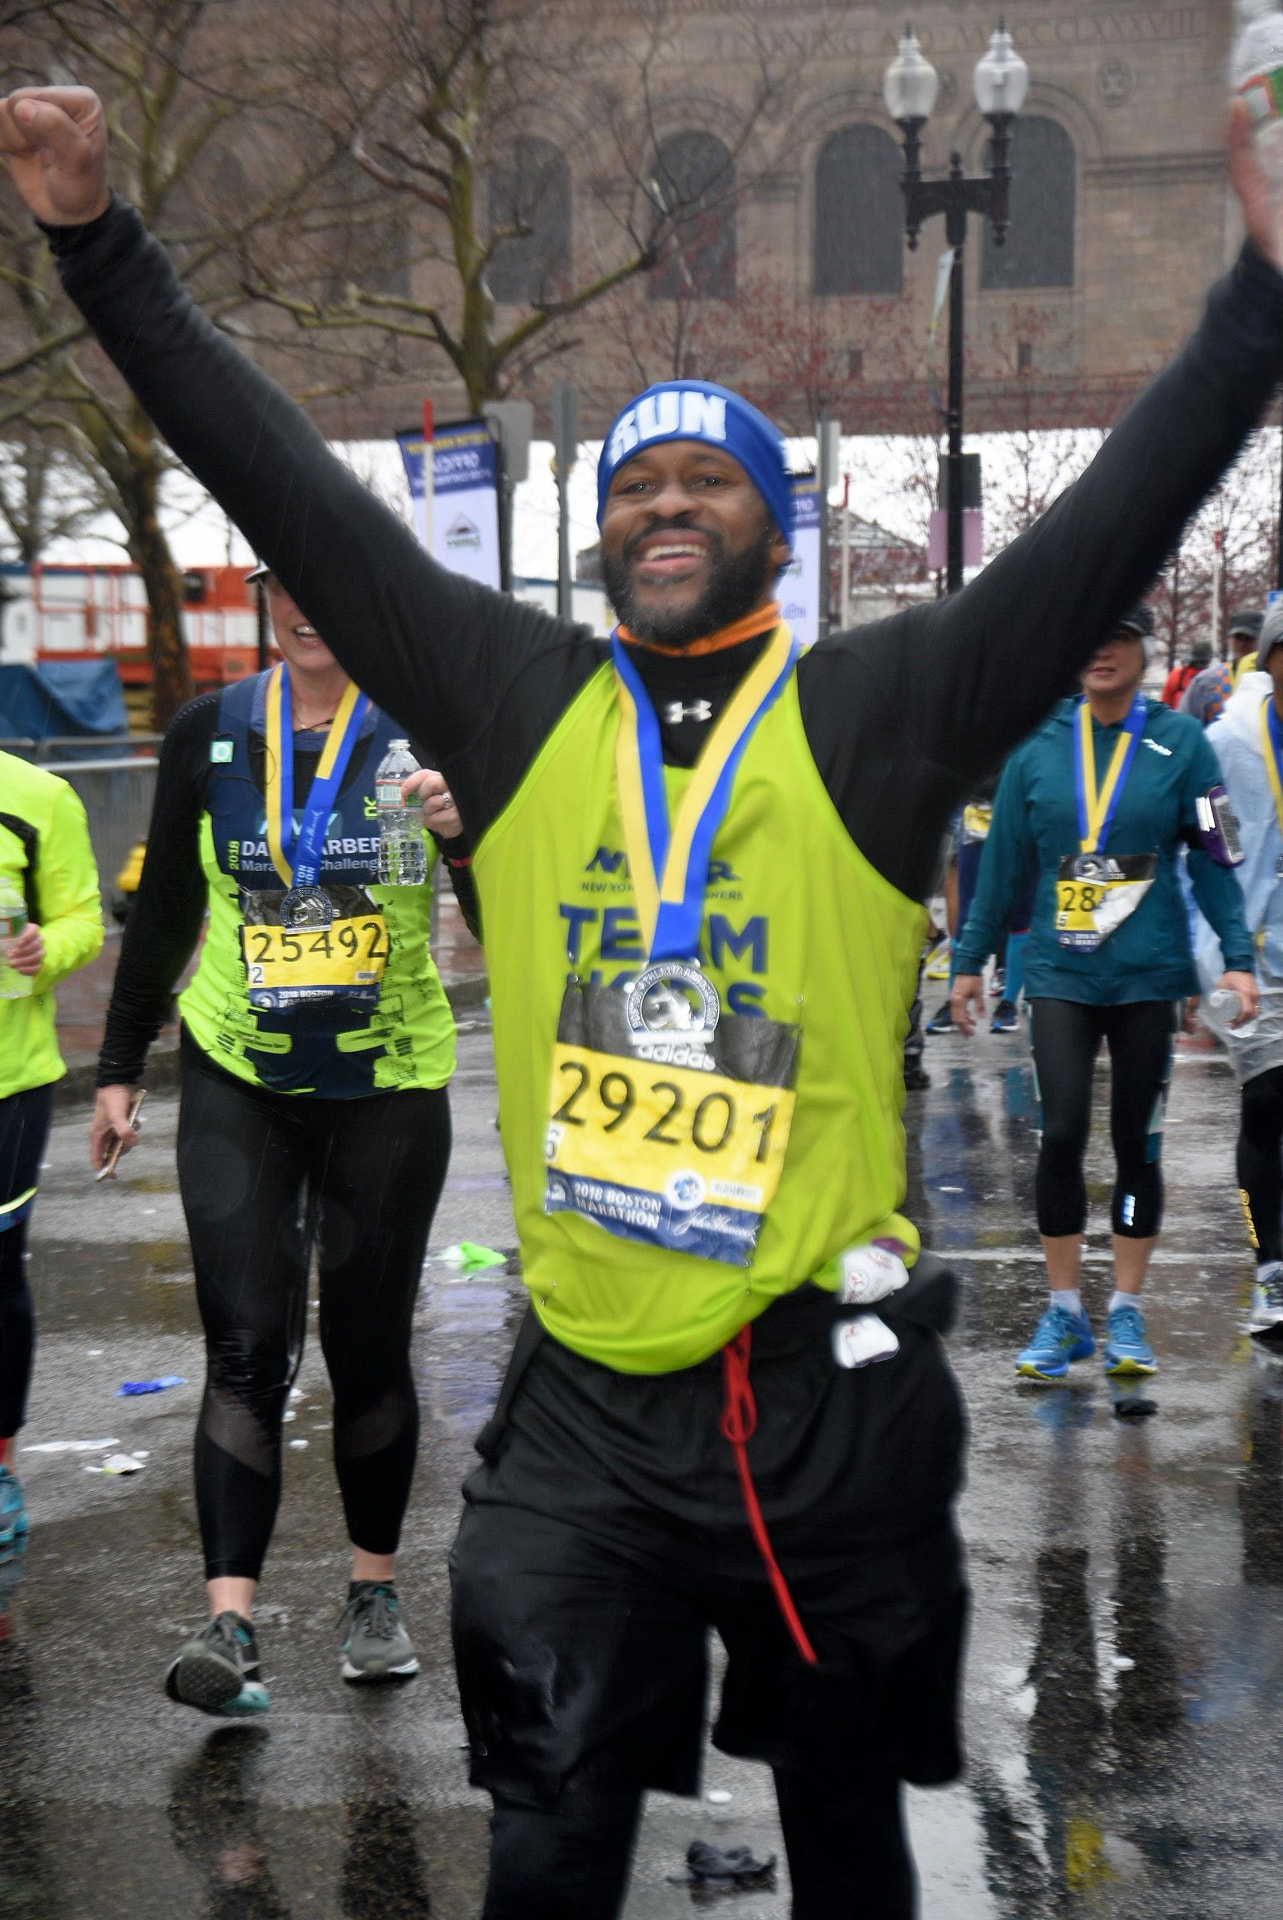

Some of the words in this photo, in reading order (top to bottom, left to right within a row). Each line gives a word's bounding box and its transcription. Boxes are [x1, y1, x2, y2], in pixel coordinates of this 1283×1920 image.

[607, 391, 728, 466] RUN
[229, 840, 240, 870] 2018
[582, 881, 607, 891] NEW
[611, 884, 634, 894] YOR
[251, 922, 387, 963] 25492
[559, 903, 769, 974] TEM
[252, 966, 263, 984] 2
[638, 1044, 716, 1071] adidas
[552, 1061, 778, 1163] 29201
[574, 1182, 603, 1201] 2018
[606, 1187, 662, 1212] BOSTON
[576, 1199, 660, 1229] MARATHON
